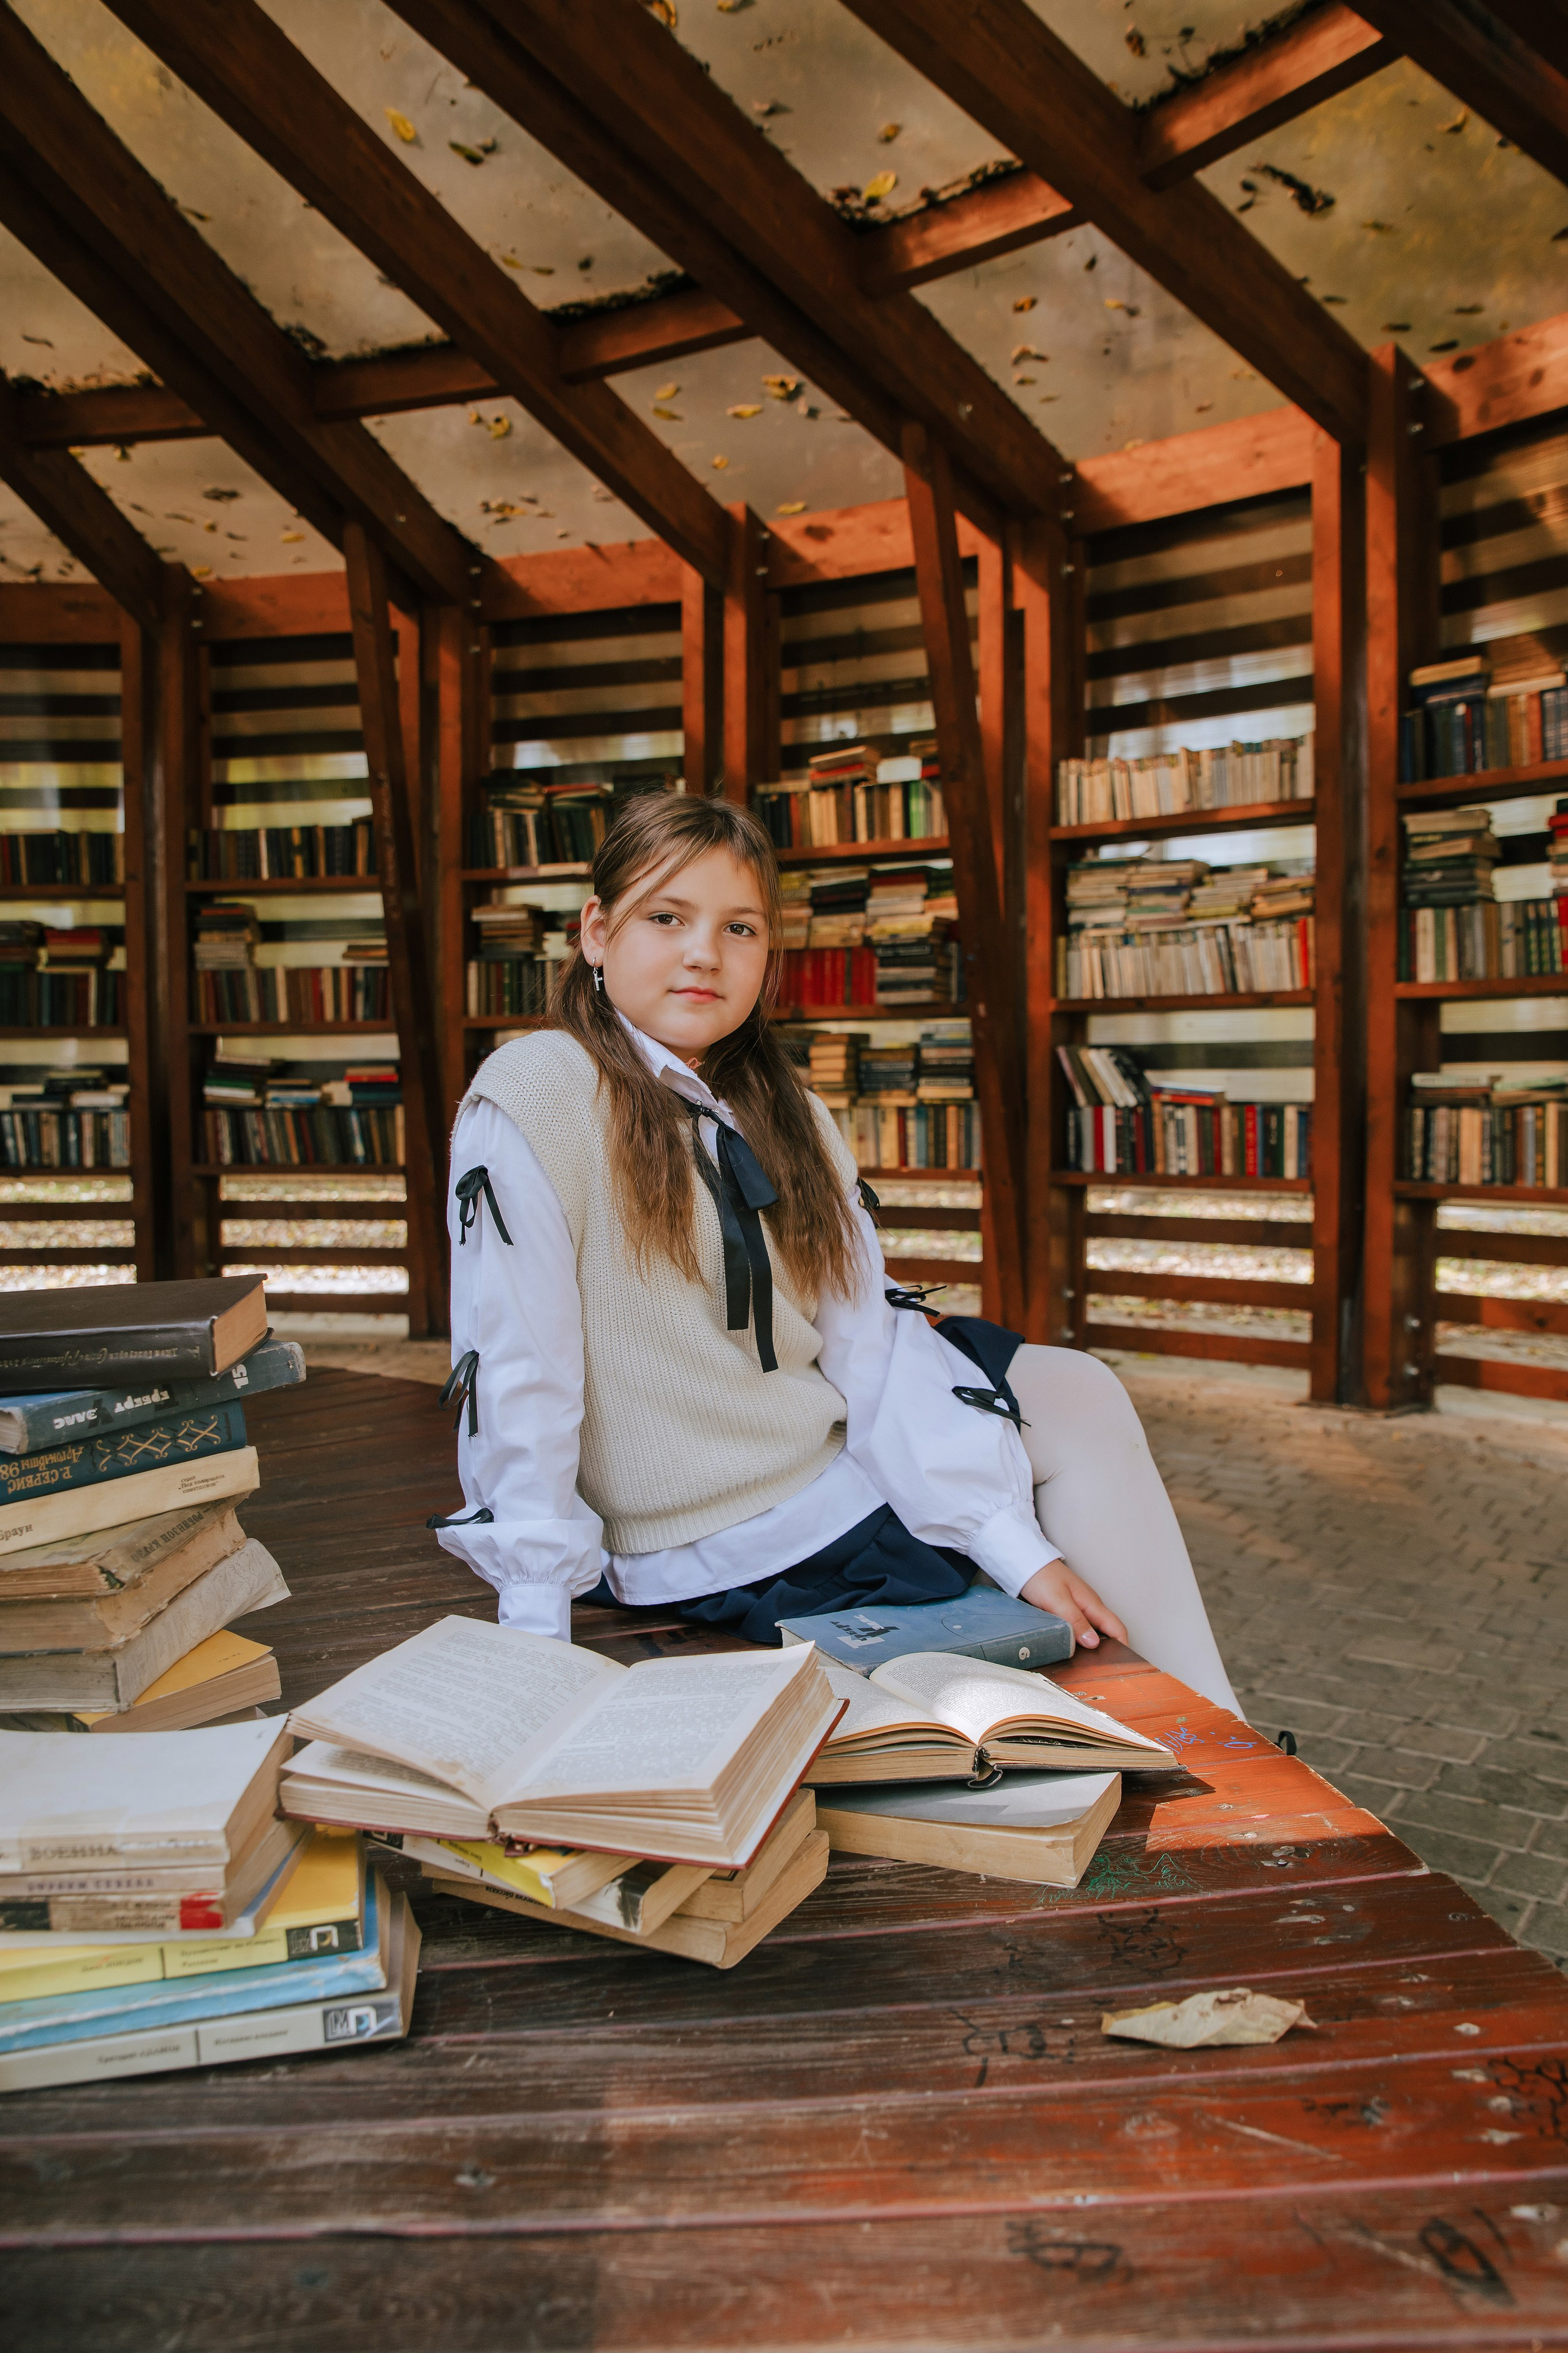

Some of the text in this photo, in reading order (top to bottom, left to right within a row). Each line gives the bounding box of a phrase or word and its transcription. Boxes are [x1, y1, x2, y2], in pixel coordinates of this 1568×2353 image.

[231, 1364, 249, 1389] 15
[130, 1511, 205, 1563] РОБИНЗОН КРУЗО
